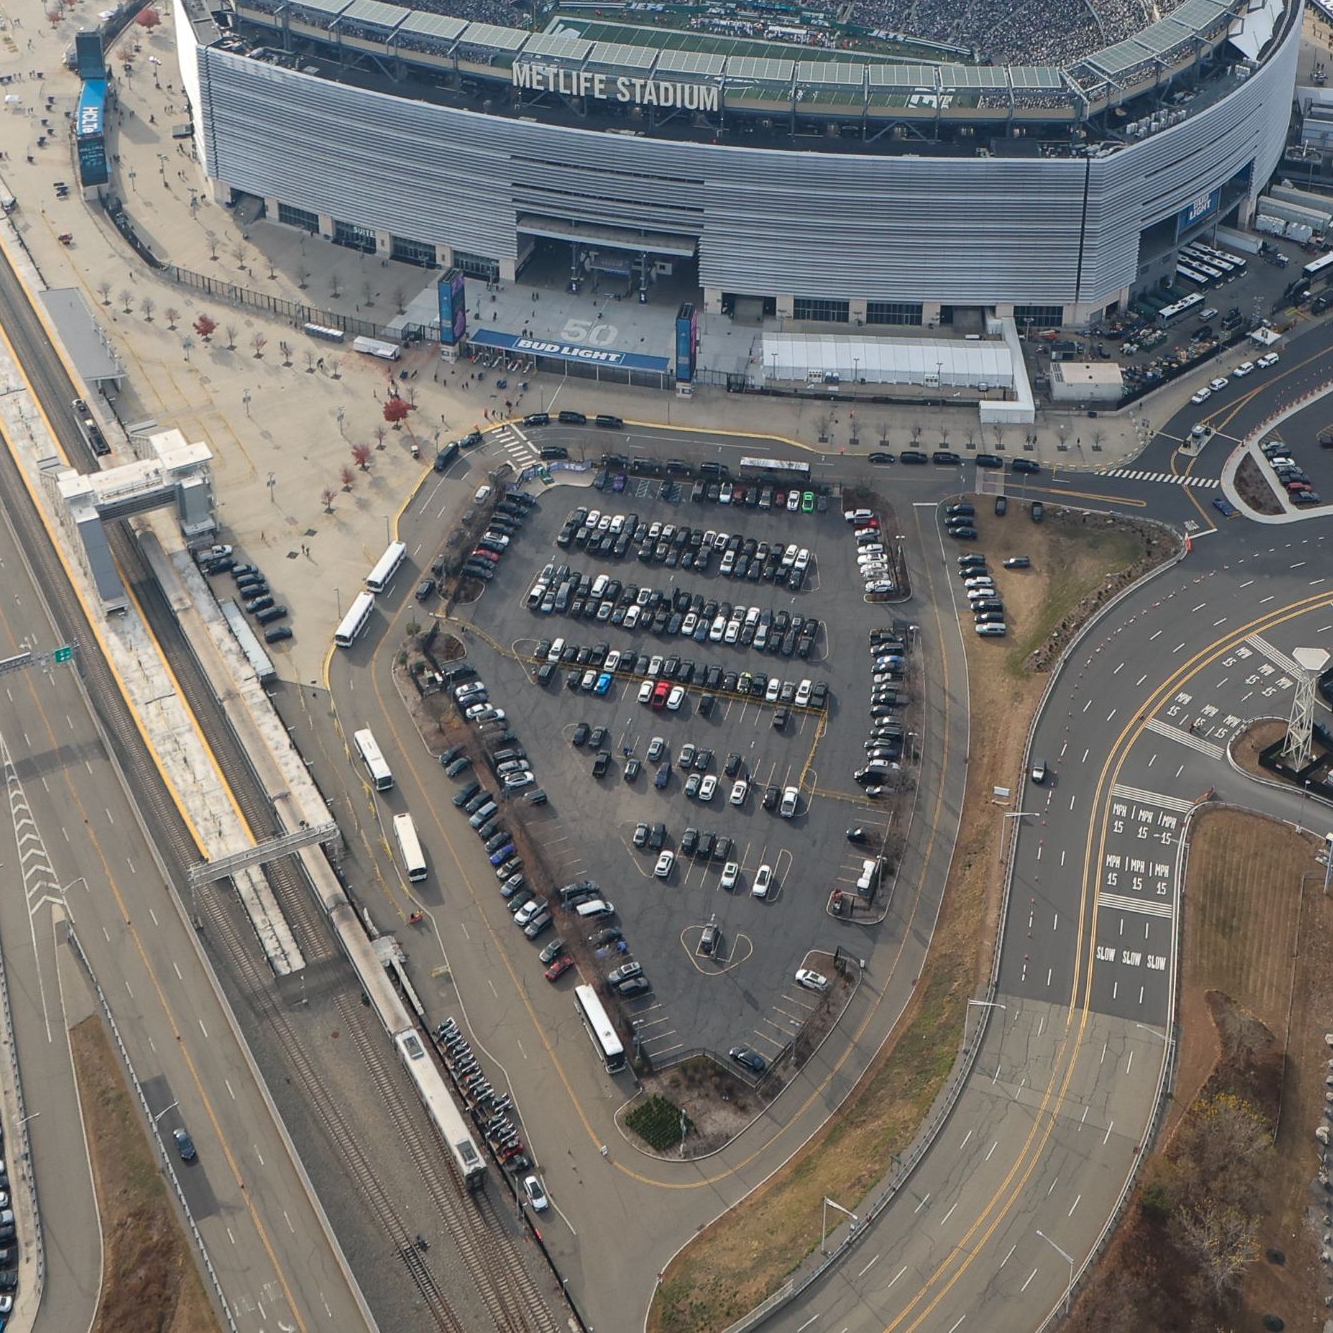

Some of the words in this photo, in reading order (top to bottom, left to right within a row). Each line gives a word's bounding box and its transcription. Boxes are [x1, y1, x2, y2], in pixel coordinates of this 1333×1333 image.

[512, 62, 607, 99] METLIFE
[617, 77, 718, 111] STADIUM
[353, 226, 374, 237] SUITE
[561, 318, 618, 347] 50
[517, 340, 560, 353] BUD
[562, 347, 621, 362] LIGHT
[1222, 657, 1237, 667] 15
[1245, 674, 1260, 685] 15
[1261, 687, 1276, 697] 15
[1167, 705, 1181, 717] 15
[1214, 727, 1228, 739] 15
[1113, 803, 1127, 817] MPH
[1138, 810, 1153, 824] MPH
[1113, 820, 1124, 833] 15
[1162, 815, 1177, 829] MPH
[1137, 826, 1148, 839] 15
[1160, 832, 1172, 845] 15
[1106, 854, 1121, 868] MPH
[1131, 859, 1145, 873] MPH
[1155, 863, 1170, 878] MPH
[1107, 872, 1118, 886] 15
[1132, 877, 1142, 890] 15
[1156, 881, 1167, 895] 15
[1096, 946, 1116, 962] SLOW
[1122, 950, 1142, 966] SLOW
[1147, 955, 1166, 970] SLOW
